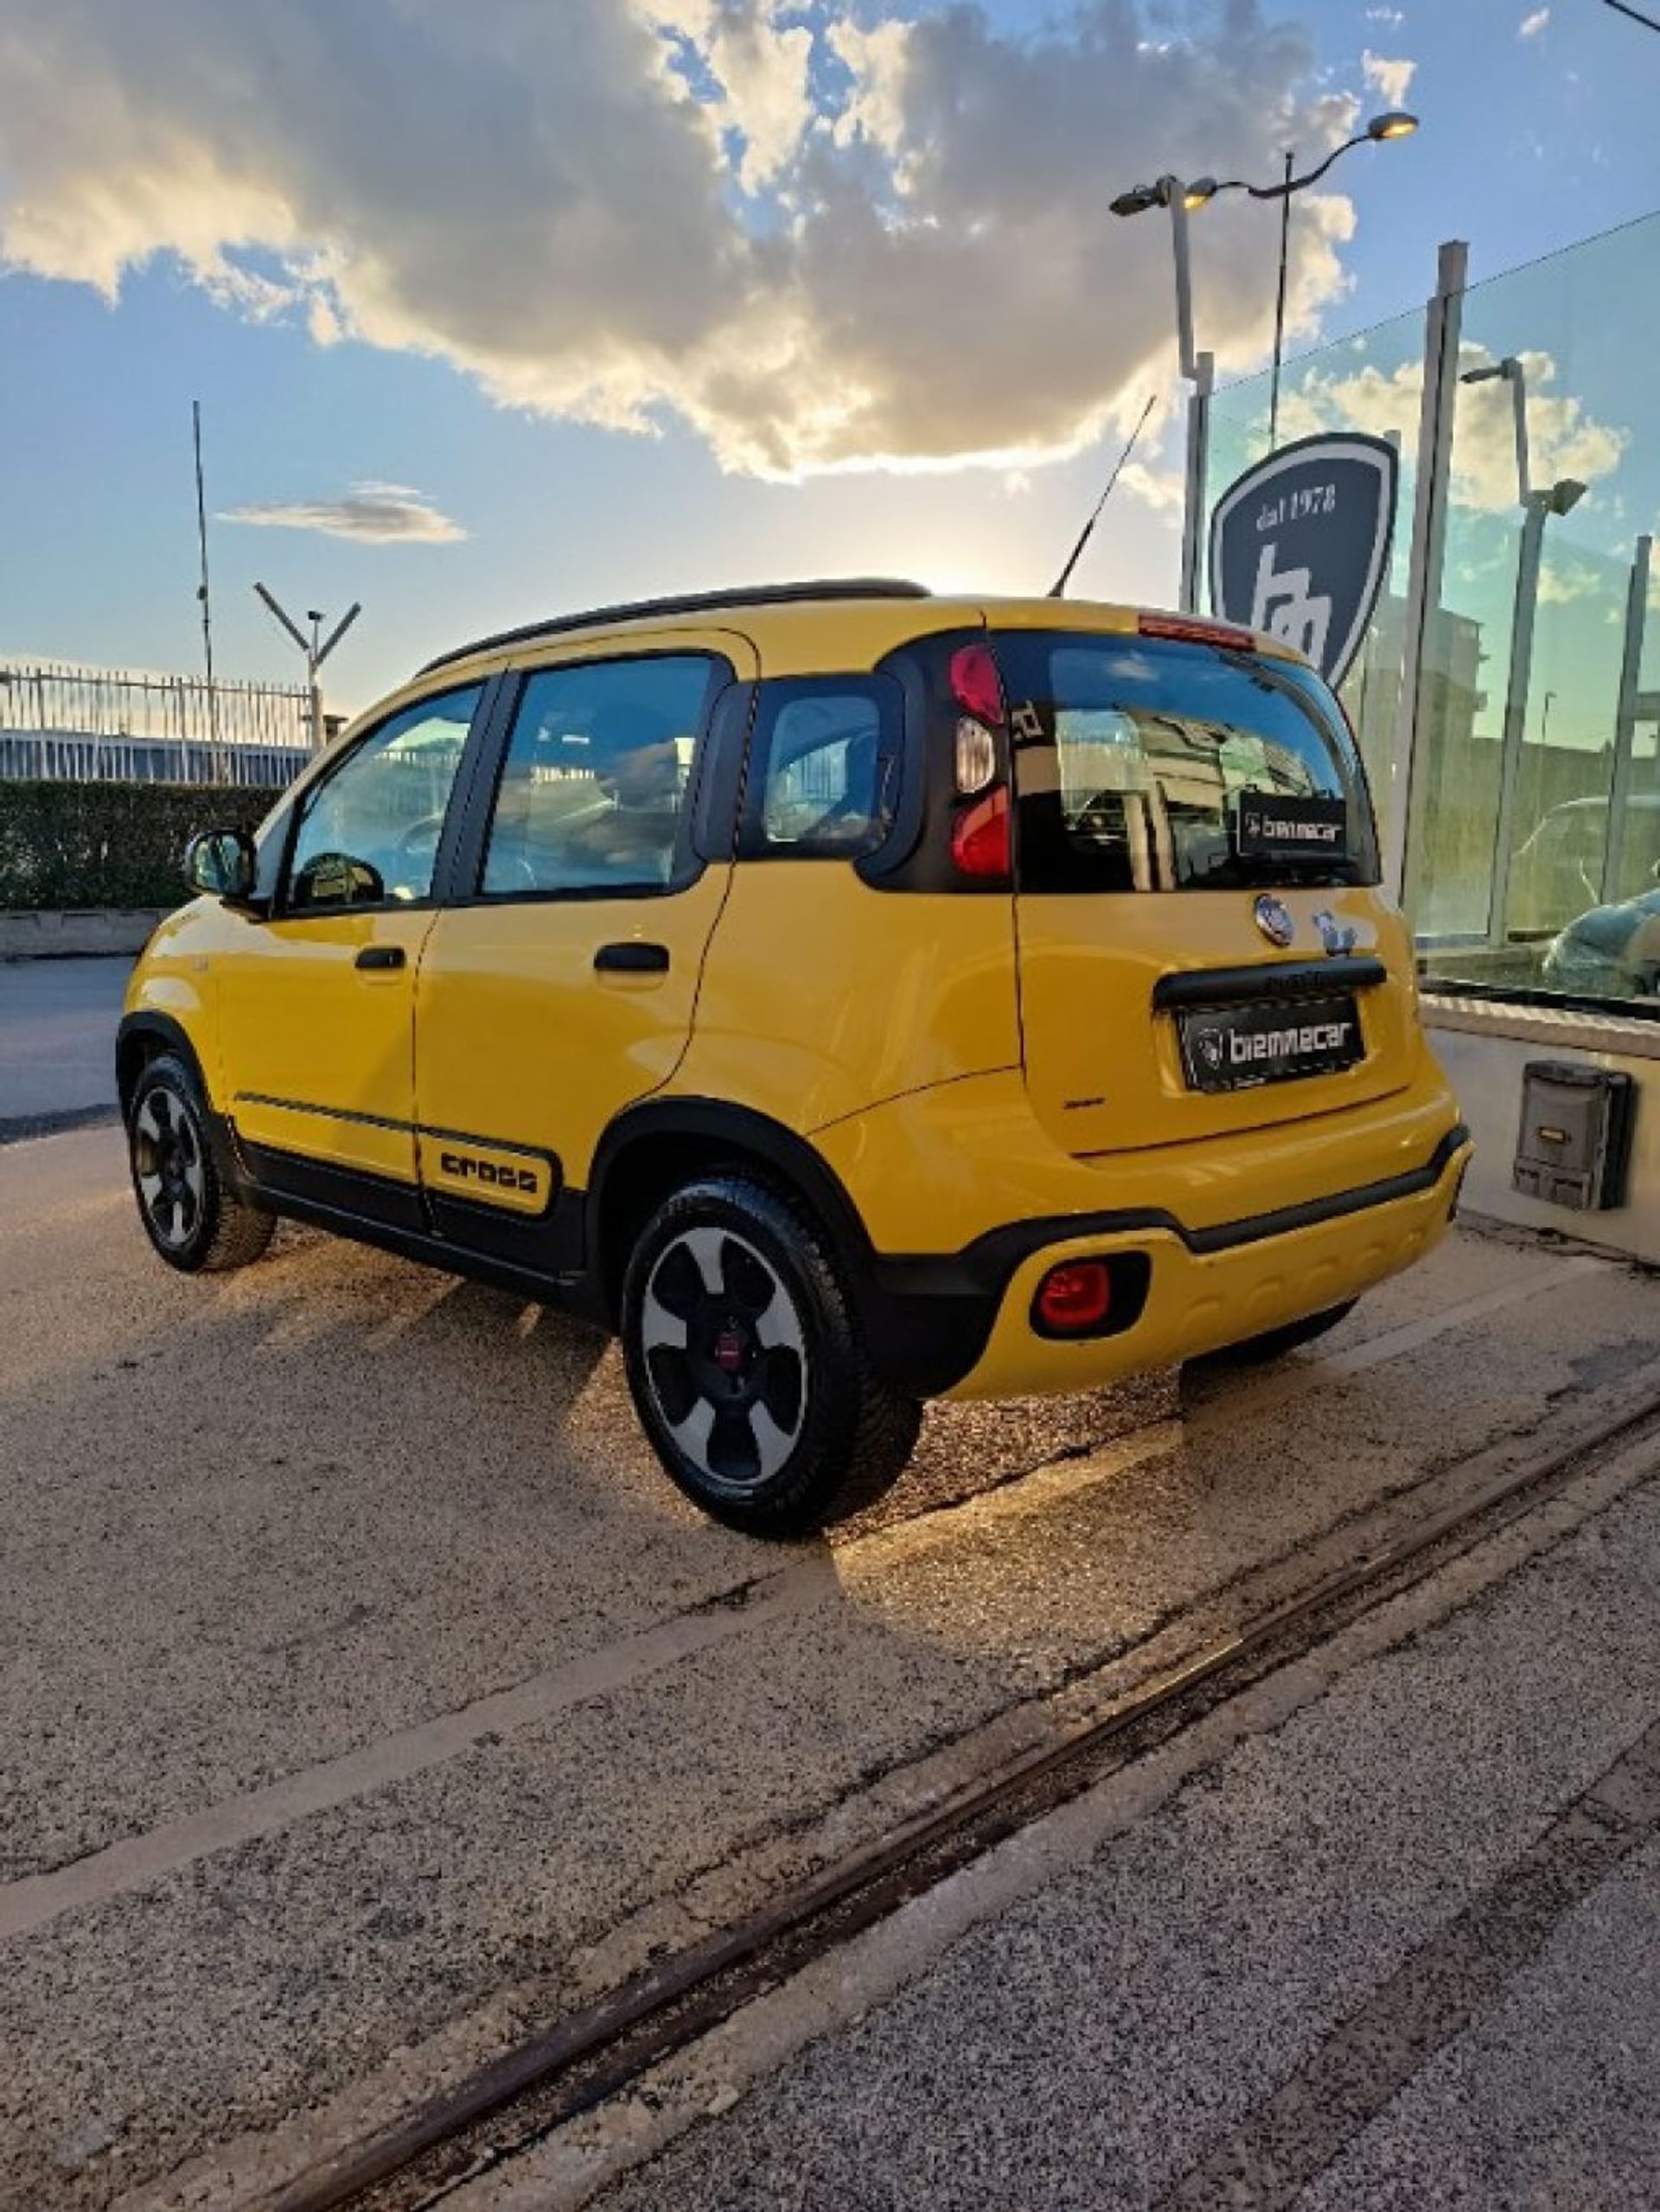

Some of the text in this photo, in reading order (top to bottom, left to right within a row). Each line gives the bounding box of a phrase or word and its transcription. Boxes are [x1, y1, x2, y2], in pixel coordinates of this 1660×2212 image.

[1256, 483, 1336, 532] dal 1978
[440, 1151, 538, 1194] cross
